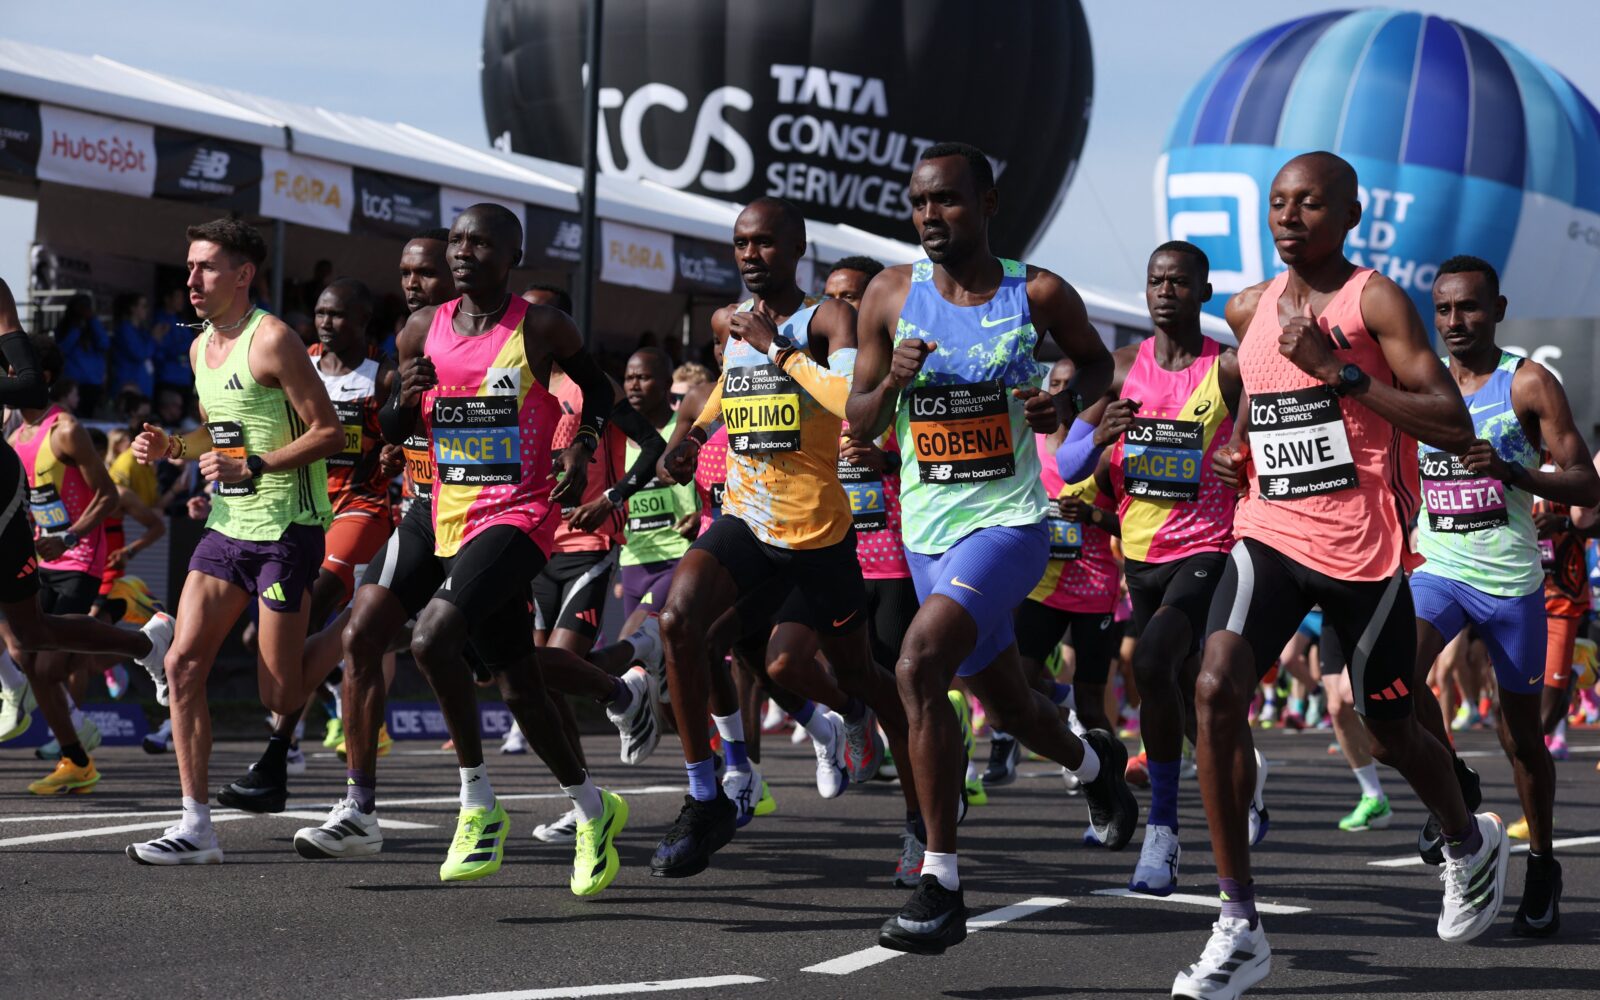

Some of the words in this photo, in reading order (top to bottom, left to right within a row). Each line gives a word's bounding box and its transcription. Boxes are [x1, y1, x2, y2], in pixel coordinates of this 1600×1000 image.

[770, 64, 888, 117] TATA
[52, 130, 146, 173] HubSpot
[768, 114, 1008, 185] CONSULTY
[766, 162, 913, 220] SERVICES
[726, 374, 750, 393] tcs
[752, 375, 792, 384] CONSULTANCY
[752, 383, 777, 391] SERVICES
[914, 394, 947, 416] tcs
[950, 394, 1000, 406] CONSULTANCY
[1277, 397, 1298, 406] TATA
[1279, 400, 1331, 415] CONSULTANCY
[435, 402, 464, 423] tcs
[466, 408, 512, 416] CONSULTANCY
[725, 404, 795, 429] KIPLIMO
[951, 405, 983, 414] SERVICES
[1252, 399, 1278, 425] tcs
[1281, 412, 1313, 423] SERVICES
[917, 426, 1009, 457] GOBENA
[1156, 430, 1198, 439] CONSULTANCY
[438, 437, 495, 460] PACE
[500, 437, 512, 459] 1
[761, 440, 792, 449] balance
[1264, 436, 1335, 469] SAWE
[972, 467, 1007, 478] balance
[1128, 453, 1178, 477] PACE
[1182, 458, 1196, 479] 9
[1423, 459, 1449, 476] tcs
[481, 474, 513, 482] balance
[1291, 485, 1309, 494] new
[1309, 478, 1348, 491] balance
[1162, 489, 1191, 498] balance
[1427, 486, 1502, 510] GELETA
[630, 496, 665, 514] ASOI
[1470, 519, 1500, 528] balance
